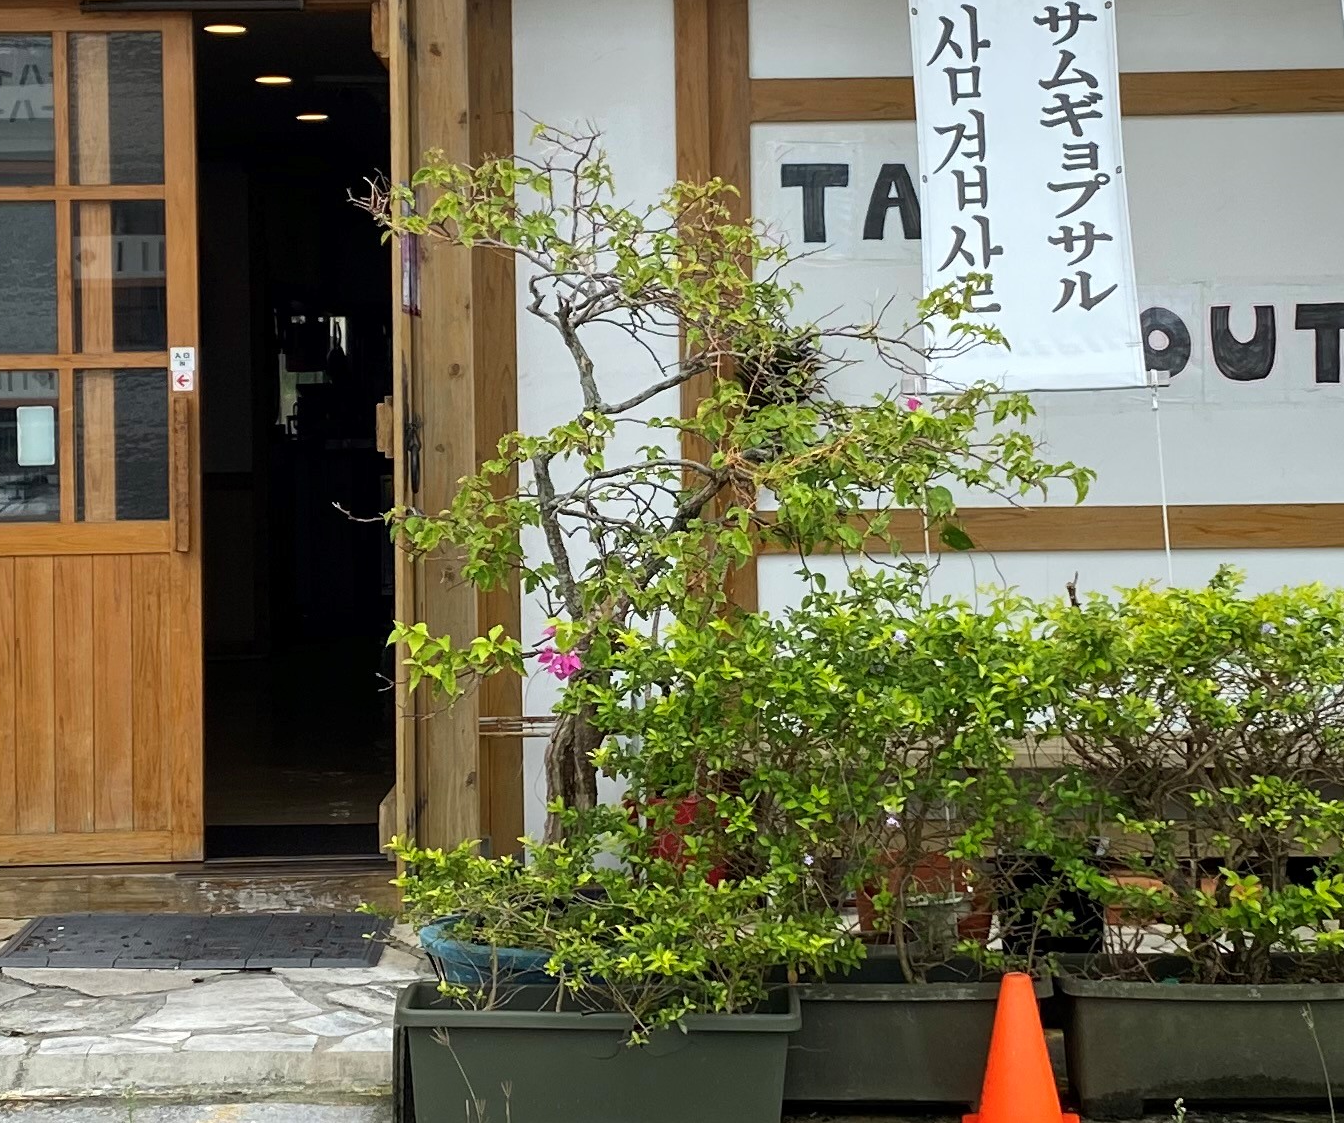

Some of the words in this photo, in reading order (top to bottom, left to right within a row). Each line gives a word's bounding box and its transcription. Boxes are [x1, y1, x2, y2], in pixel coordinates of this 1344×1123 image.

[780, 162, 924, 244] TA
[926, 2, 1005, 313] 삼겹살
[1032, 0, 1119, 314] サムギョプサル
